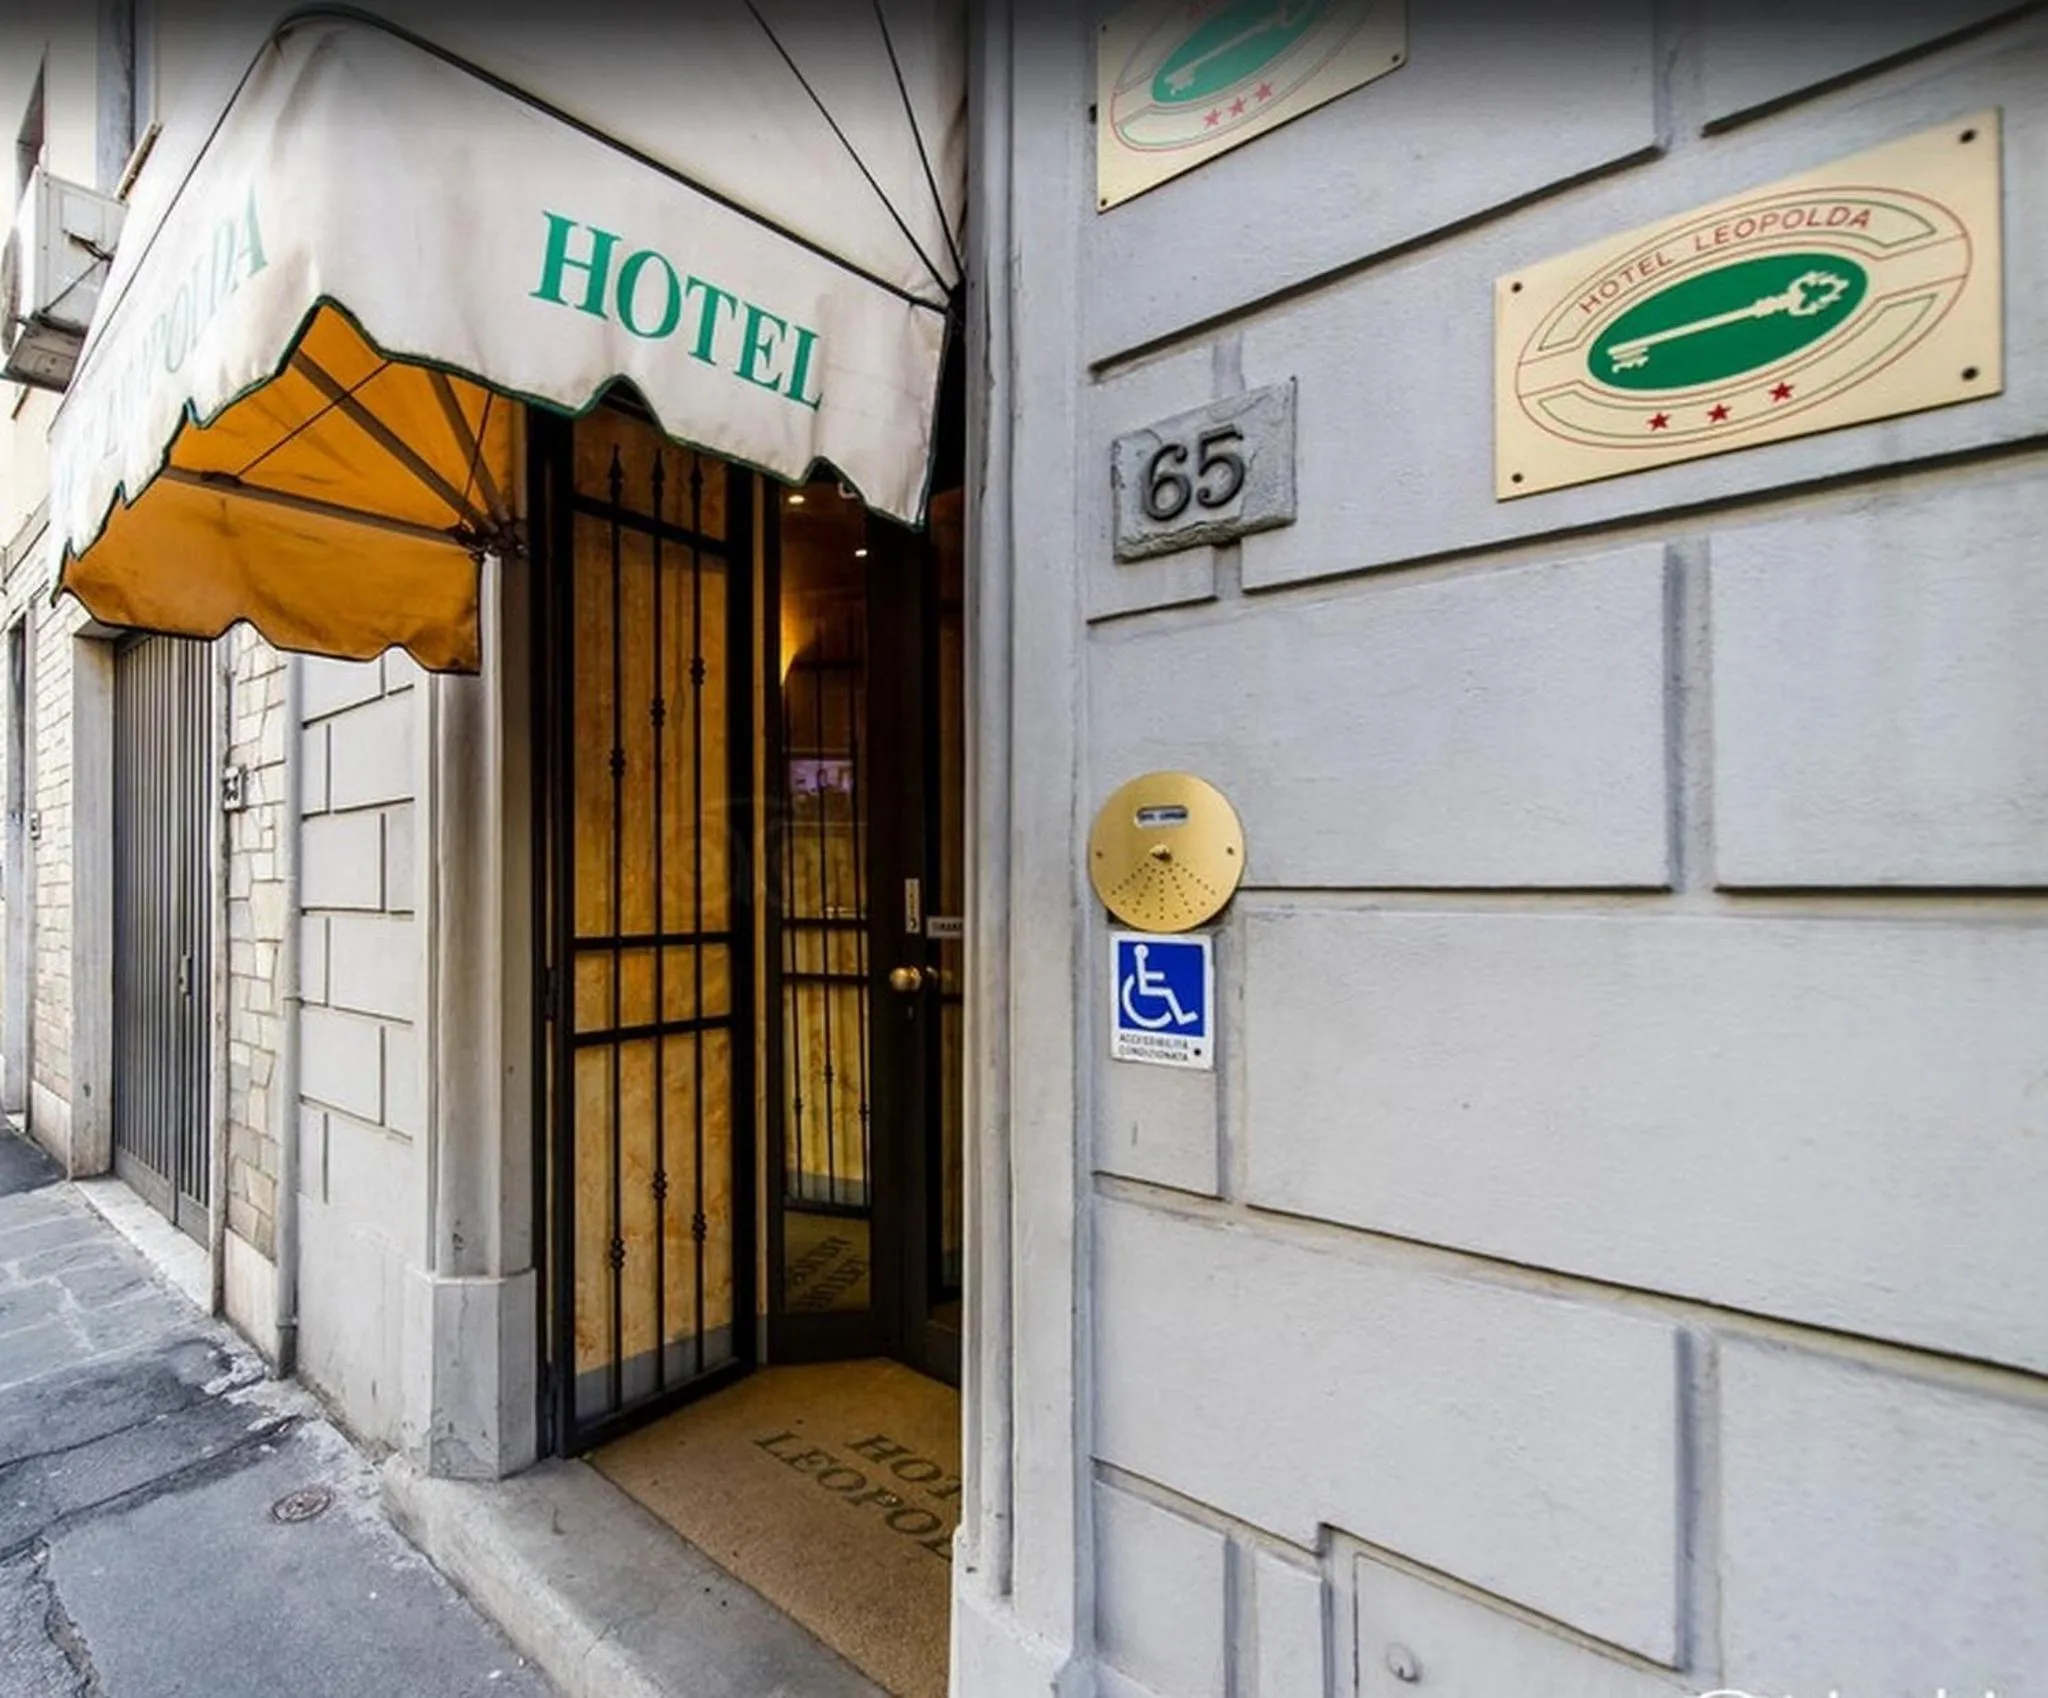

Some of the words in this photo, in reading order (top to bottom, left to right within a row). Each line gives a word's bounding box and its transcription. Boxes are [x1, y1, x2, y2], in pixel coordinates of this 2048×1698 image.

[529, 210, 824, 411] HOTEL
[1577, 251, 1673, 315] HOTEL
[1694, 206, 1872, 252] LEOPOLDA
[1141, 423, 1246, 523] 65
